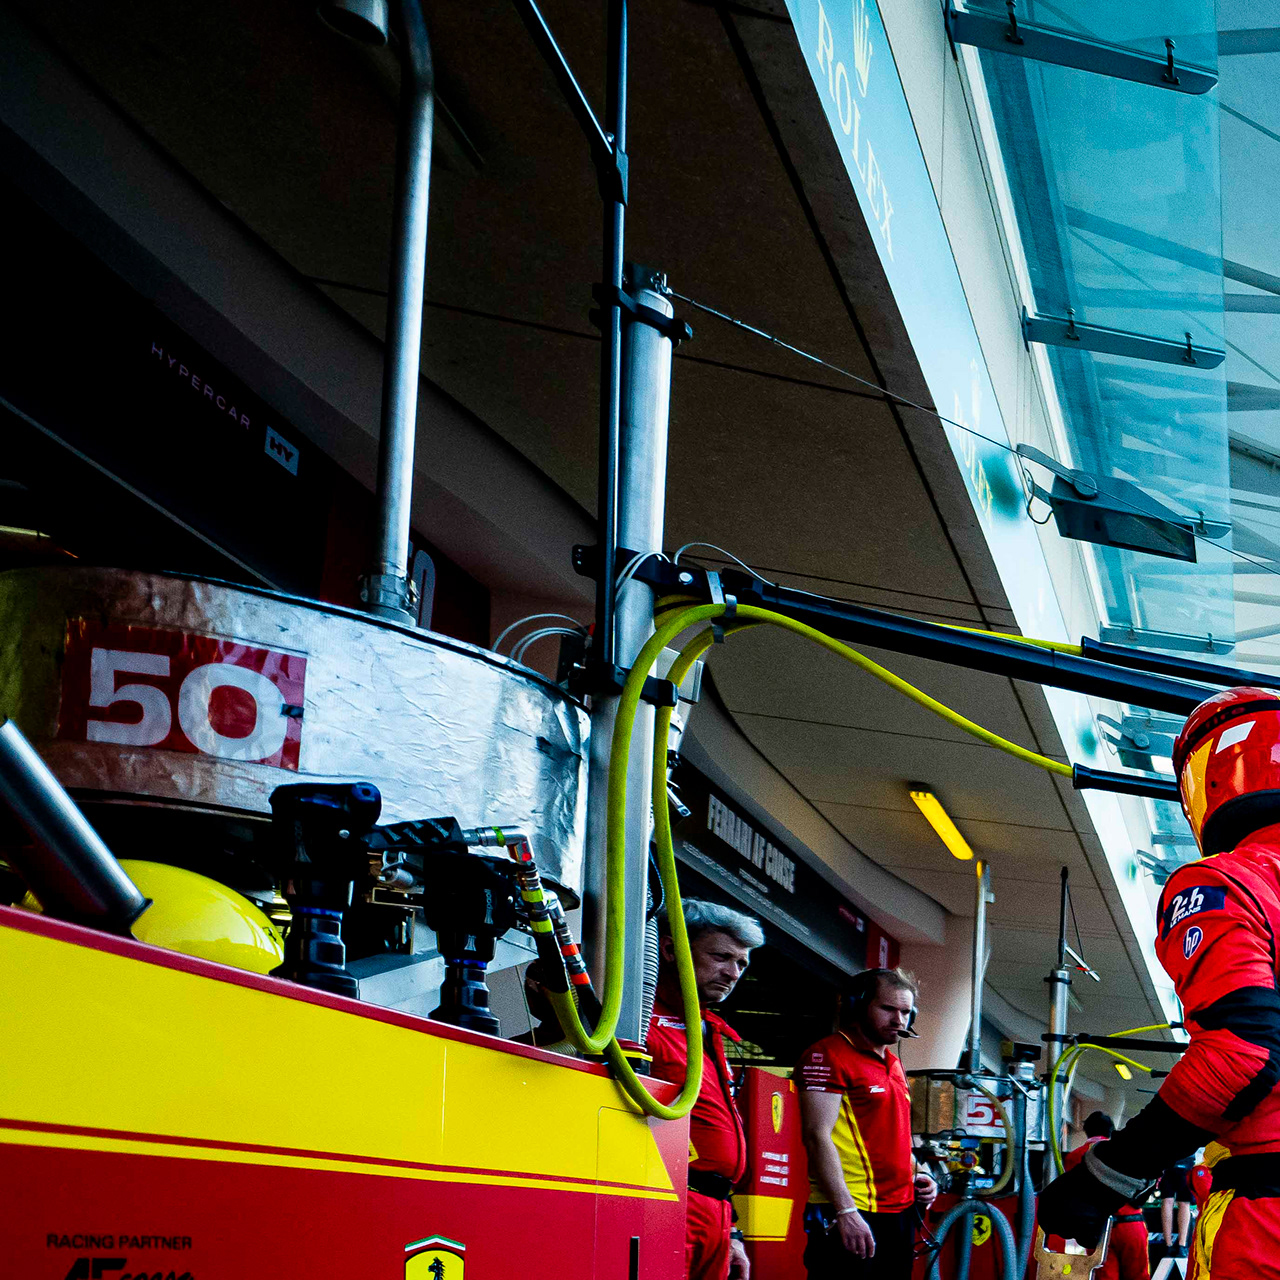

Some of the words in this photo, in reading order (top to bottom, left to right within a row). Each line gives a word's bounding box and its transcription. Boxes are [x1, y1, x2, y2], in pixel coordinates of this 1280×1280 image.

[816, 0, 895, 263] ROLEX
[151, 341, 251, 430] HYPERCAR
[269, 436, 294, 463] HY
[86, 647, 288, 761] 50
[765, 841, 796, 894] CORSE
[46, 1233, 114, 1250] RACING
[118, 1234, 192, 1250] PARTNER
